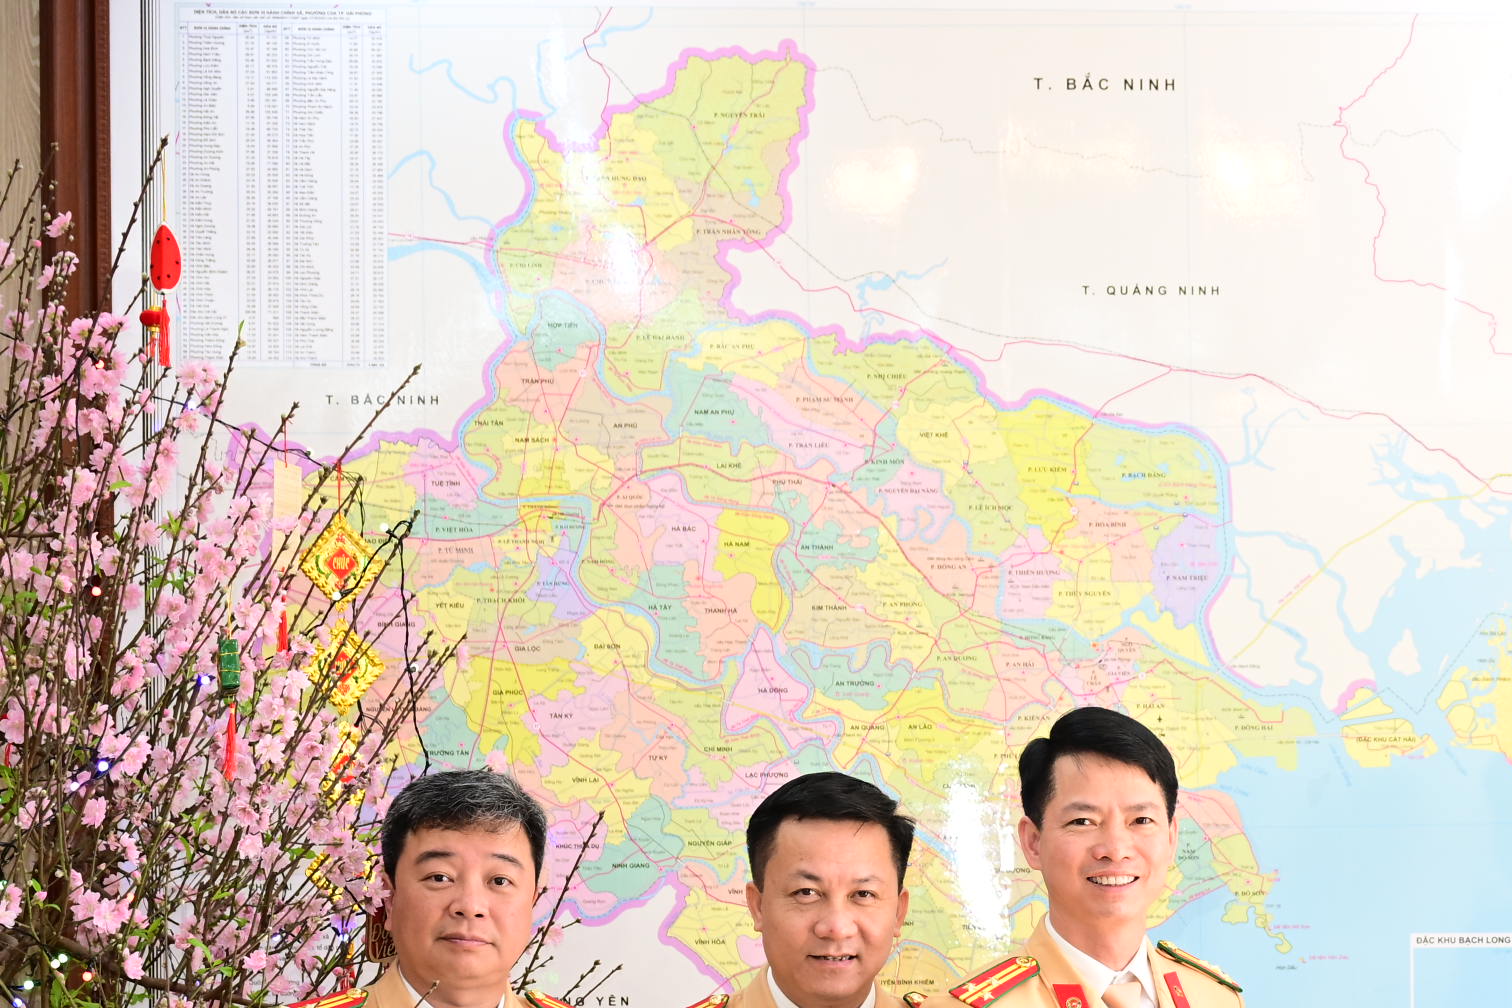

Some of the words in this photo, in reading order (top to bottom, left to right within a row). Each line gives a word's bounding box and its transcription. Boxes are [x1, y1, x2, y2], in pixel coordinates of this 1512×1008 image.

[1033, 77, 1052, 91] T.
[1066, 72, 1110, 91] BẮC
[1123, 78, 1175, 91] NINH
[1082, 285, 1095, 295] T.
[1106, 284, 1167, 295] QUẢNG
[1178, 285, 1220, 295] NINH
[325, 394, 340, 406] T.
[396, 395, 440, 406] NINH
[623, 421, 638, 429] PHÚ
[728, 461, 742, 469] KHÊ
[671, 524, 681, 532] HÀ
[723, 539, 733, 548] HÀ
[810, 542, 834, 551] THÀNH
[648, 602, 658, 611] HÀ
[658, 602, 673, 611] TÂY
[825, 603, 847, 611] THÀNH
[758, 686, 767, 694] HÀ
[918, 722, 933, 730] LÃO
[1416, 936, 1435, 946] ĐẶC
[1458, 936, 1484, 946] BẠCH
[1485, 936, 1511, 944] LONG
[596, 994, 630, 1007] YÊN
